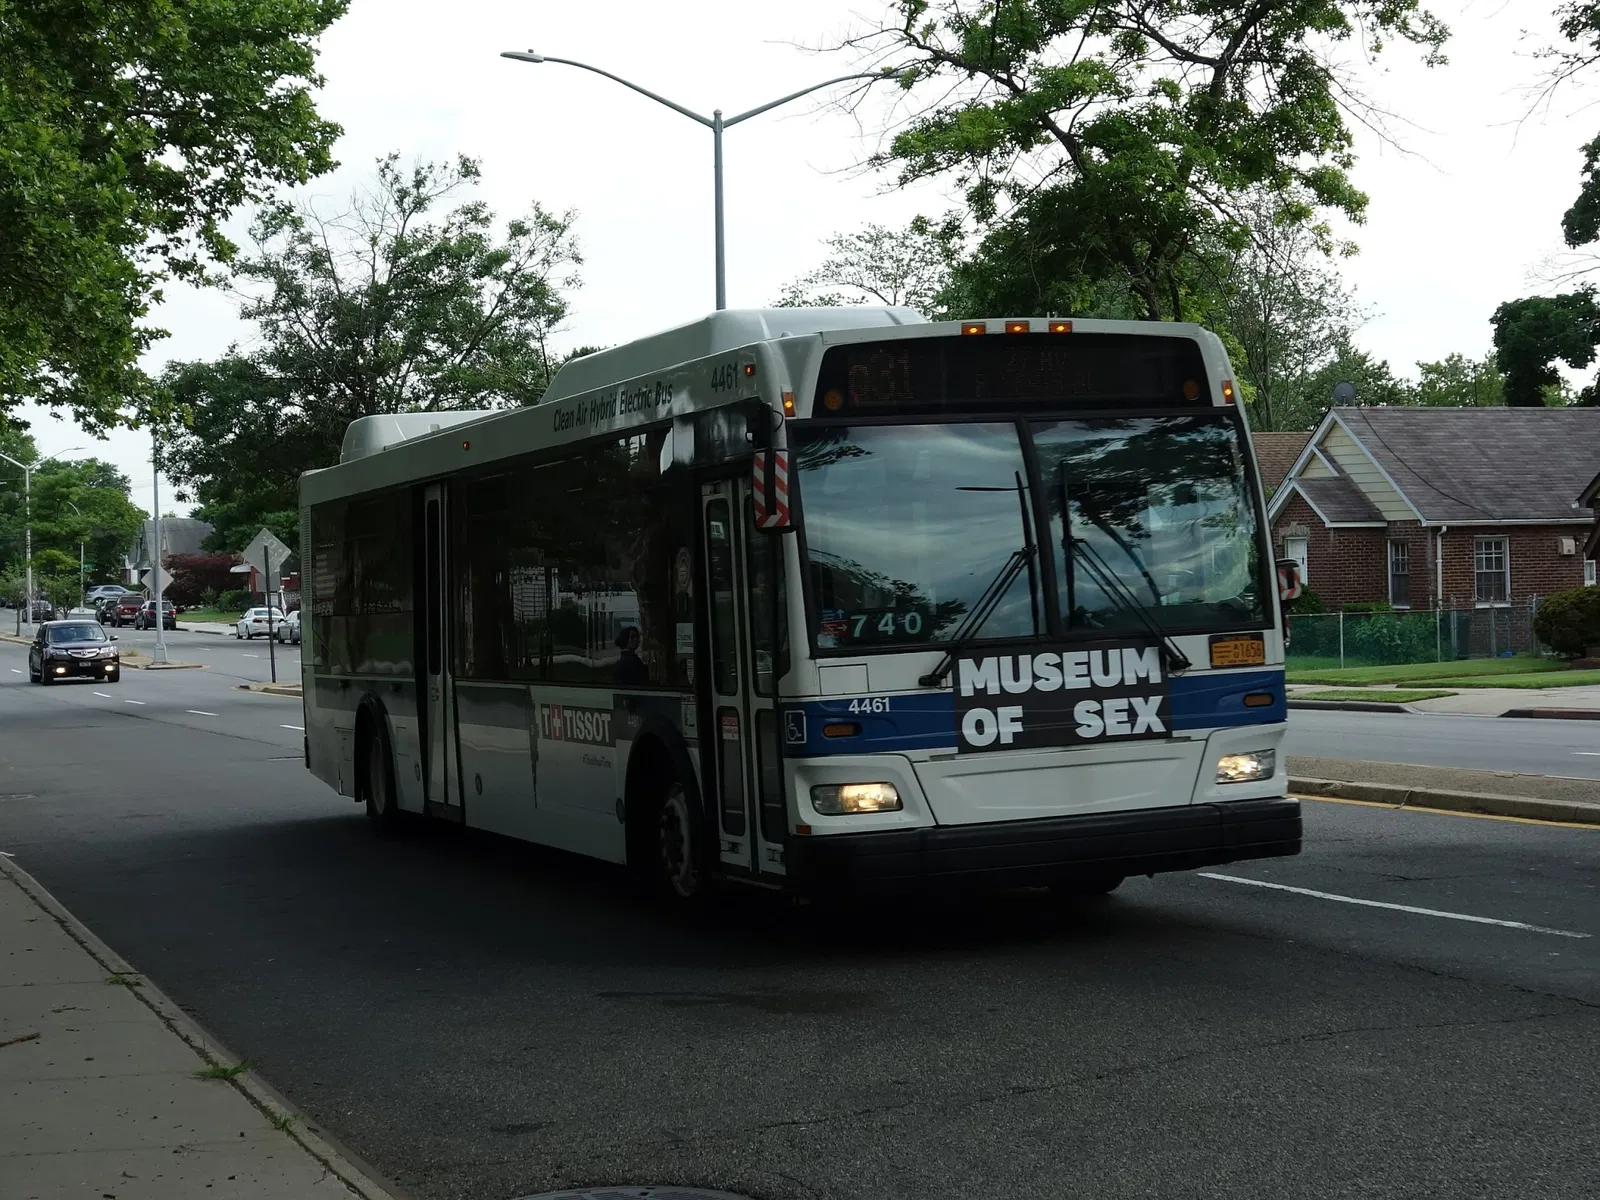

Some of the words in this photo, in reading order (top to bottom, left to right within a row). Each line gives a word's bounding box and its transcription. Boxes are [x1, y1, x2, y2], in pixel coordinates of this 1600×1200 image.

[711, 362, 739, 392] 4461
[553, 407, 575, 432] Clean
[576, 404, 588, 427] Air
[589, 393, 617, 429] Hybrid
[619, 388, 652, 415] Electric
[655, 381, 673, 407] Bus
[957, 645, 1163, 698] MUSEUM
[563, 709, 611, 742] TISSOT
[848, 696, 891, 716] 4461
[960, 705, 1025, 748] OF
[1074, 695, 1167, 740] SEX
